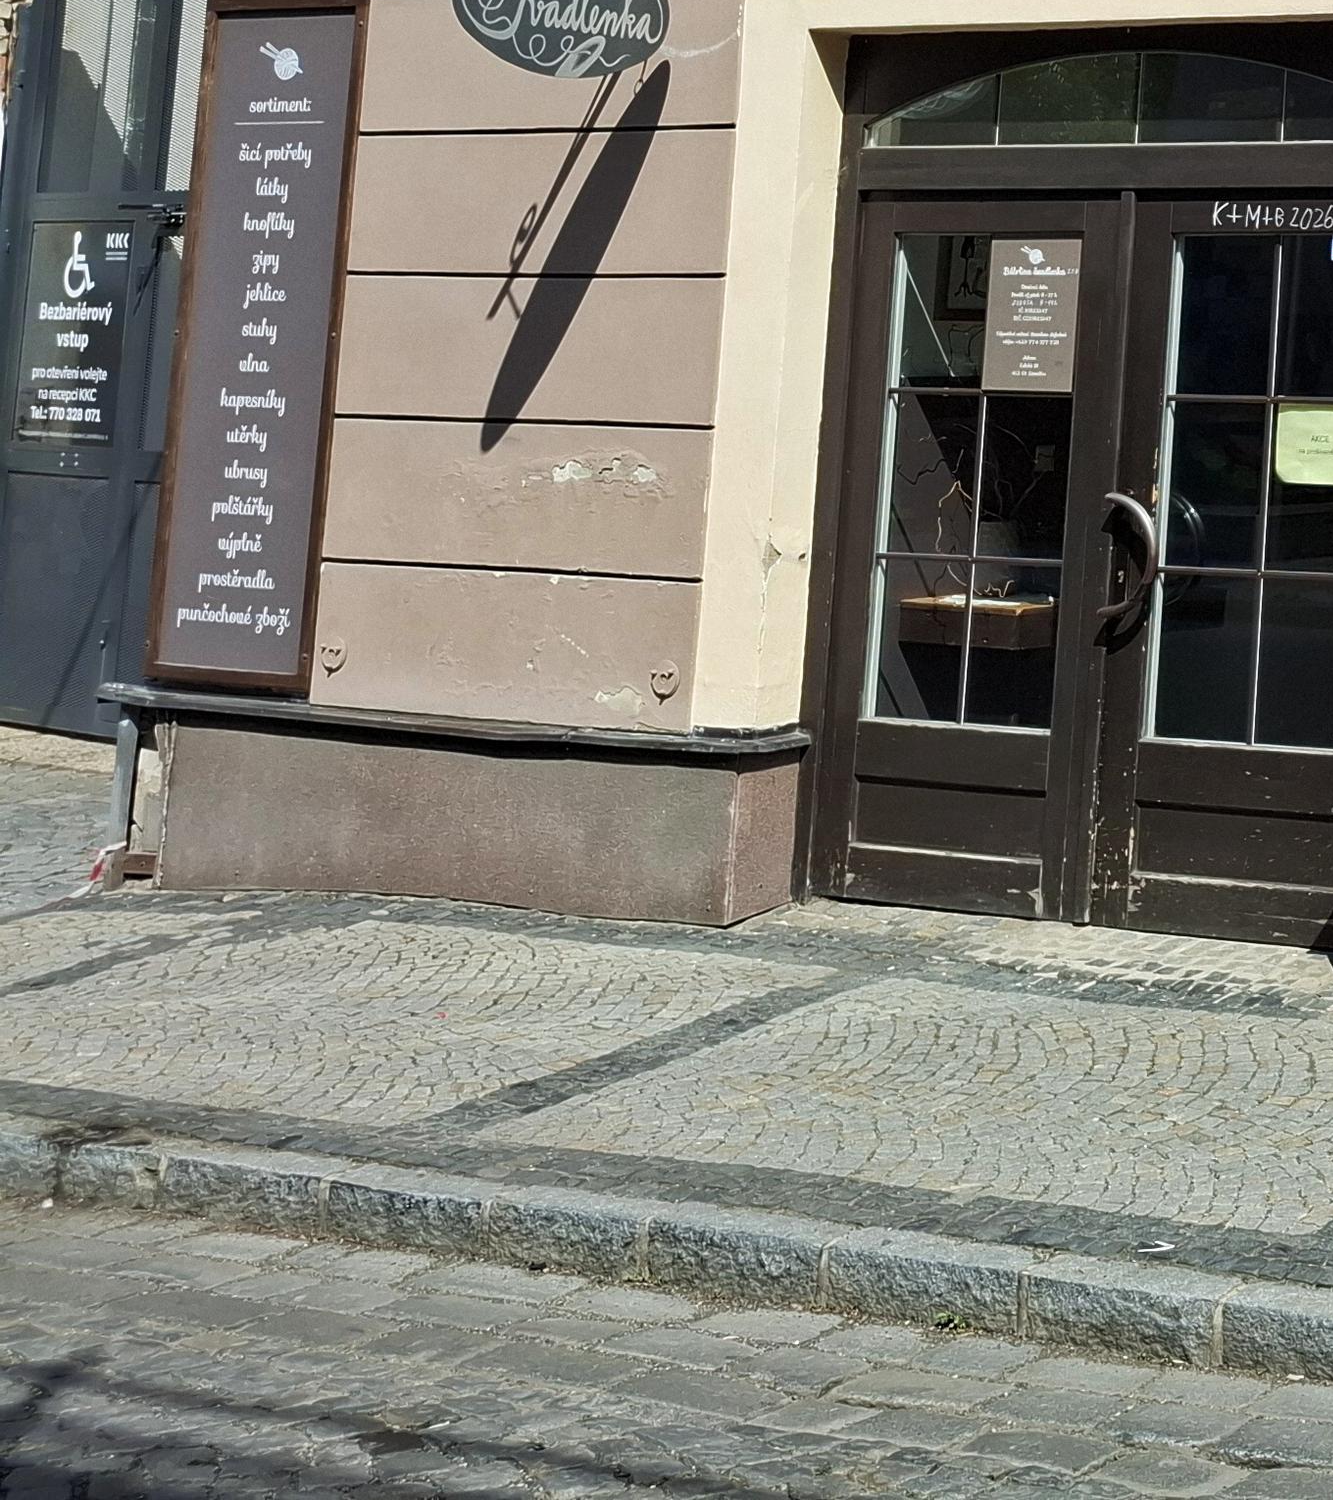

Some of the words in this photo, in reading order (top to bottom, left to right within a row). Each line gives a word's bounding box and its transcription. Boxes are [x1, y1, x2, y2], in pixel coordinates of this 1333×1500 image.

[249, 97, 312, 113] sortiment:
[238, 142, 262, 162] šicí
[264, 142, 312, 169] potřeby
[255, 177, 288, 203] látky
[243, 212, 295, 238] knoflíky
[252, 251, 279, 274] zipy
[243, 282, 286, 309] jehlice
[39, 301, 112, 326] Bezbariérový
[56, 330, 90, 352] vstup
[241, 317, 277, 344] stuhy
[31, 366, 46, 380] pro
[46, 365, 80, 380] otevření
[80, 366, 108, 384] volejte
[239, 353, 269, 372] vlna
[38, 388, 49, 400] na
[49, 388, 78, 403] recepci
[79, 388, 98, 402] KKC
[220, 387, 286, 417] kapesníky
[48, 406, 65, 421] 770
[66, 407, 83, 421] 328
[84, 408, 101, 423] 071
[226, 425, 267, 452] utěrky
[224, 460, 268, 488] ubrusy
[211, 495, 273, 524] polštářky
[218, 532, 262, 559] výplně
[198, 569, 275, 593] prostěradla
[176, 603, 253, 628] punčochové
[255, 606, 291, 635] zboží
